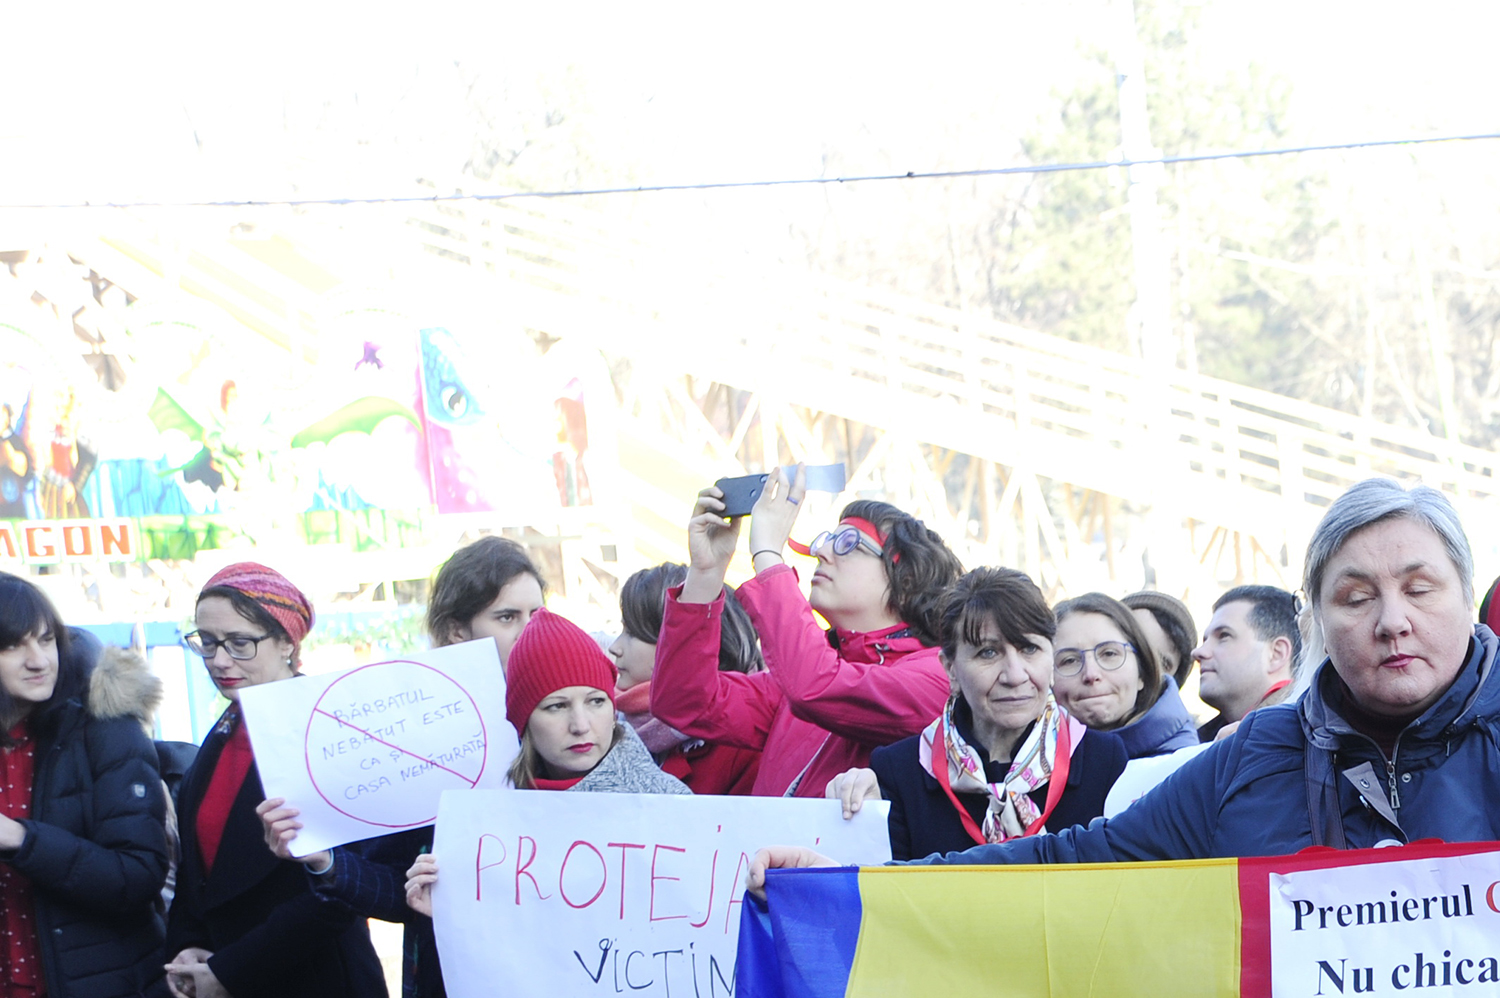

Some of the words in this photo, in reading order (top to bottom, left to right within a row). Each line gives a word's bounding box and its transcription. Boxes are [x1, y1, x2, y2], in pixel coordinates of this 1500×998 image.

[322, 719, 407, 760] NEBĂTUT
[422, 700, 465, 726] ESTE
[333, 688, 434, 729] BĂRBATUL
[344, 776, 391, 801] CASA
[400, 730, 487, 782] NEMĂTURATĂ
[360, 757, 381, 770] CA
[476, 825, 749, 935] PROTEJA
[1291, 884, 1474, 931] Premierul
[1313, 958, 1374, 996] Nu
[1391, 950, 1500, 988] chica
